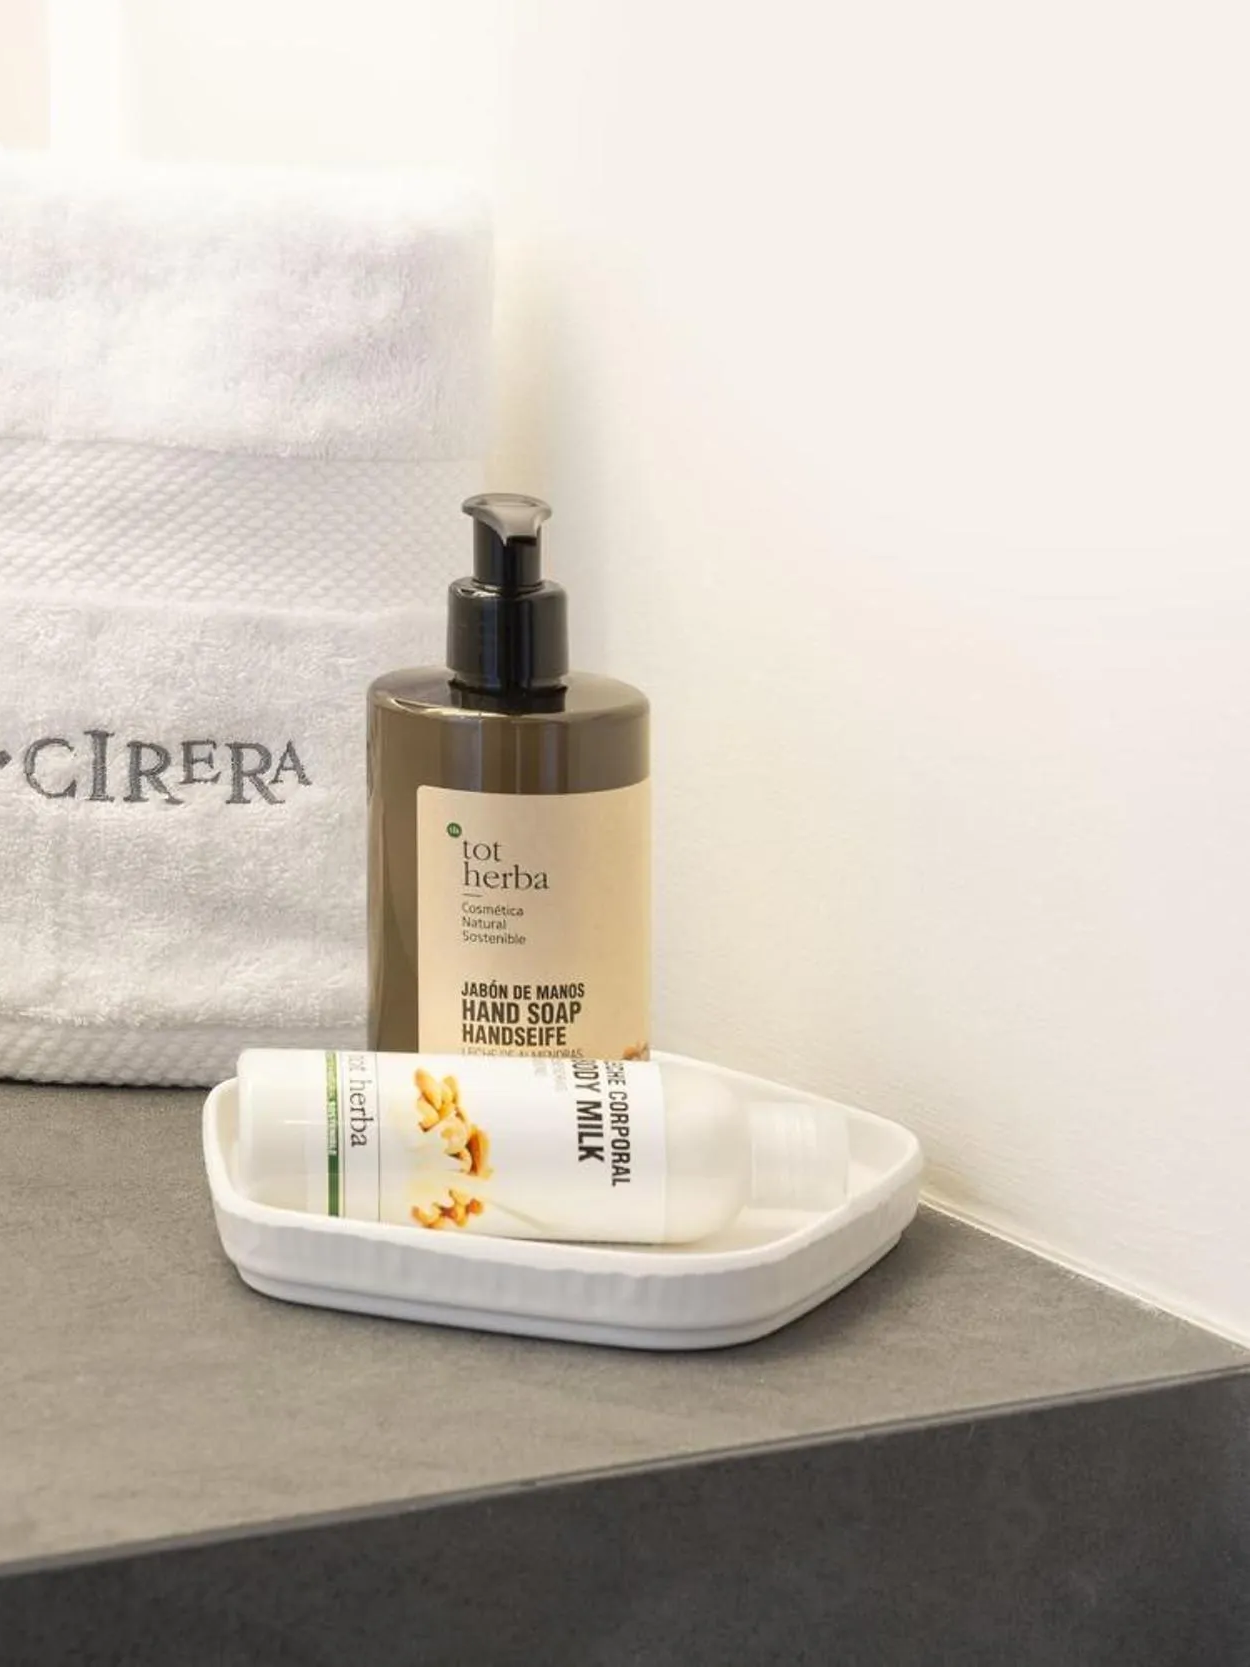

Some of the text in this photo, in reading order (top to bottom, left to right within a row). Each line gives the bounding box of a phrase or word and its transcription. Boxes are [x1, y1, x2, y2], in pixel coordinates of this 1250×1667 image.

[22, 729, 313, 806] CIRERA
[462, 840, 503, 862] tot
[462, 861, 550, 890] herba
[461, 902, 525, 917] Cosmética
[461, 916, 508, 930] Natural
[462, 930, 527, 945] Sostenible
[461, 980, 586, 1001] JABÓN DE MANOS
[462, 999, 583, 1025] HAND SOAP
[462, 1023, 567, 1047] HANDSEIFE
[349, 1079, 375, 1148] herba
[576, 1100, 605, 1162] MILK
[608, 1091, 631, 1187] CORPORAL
